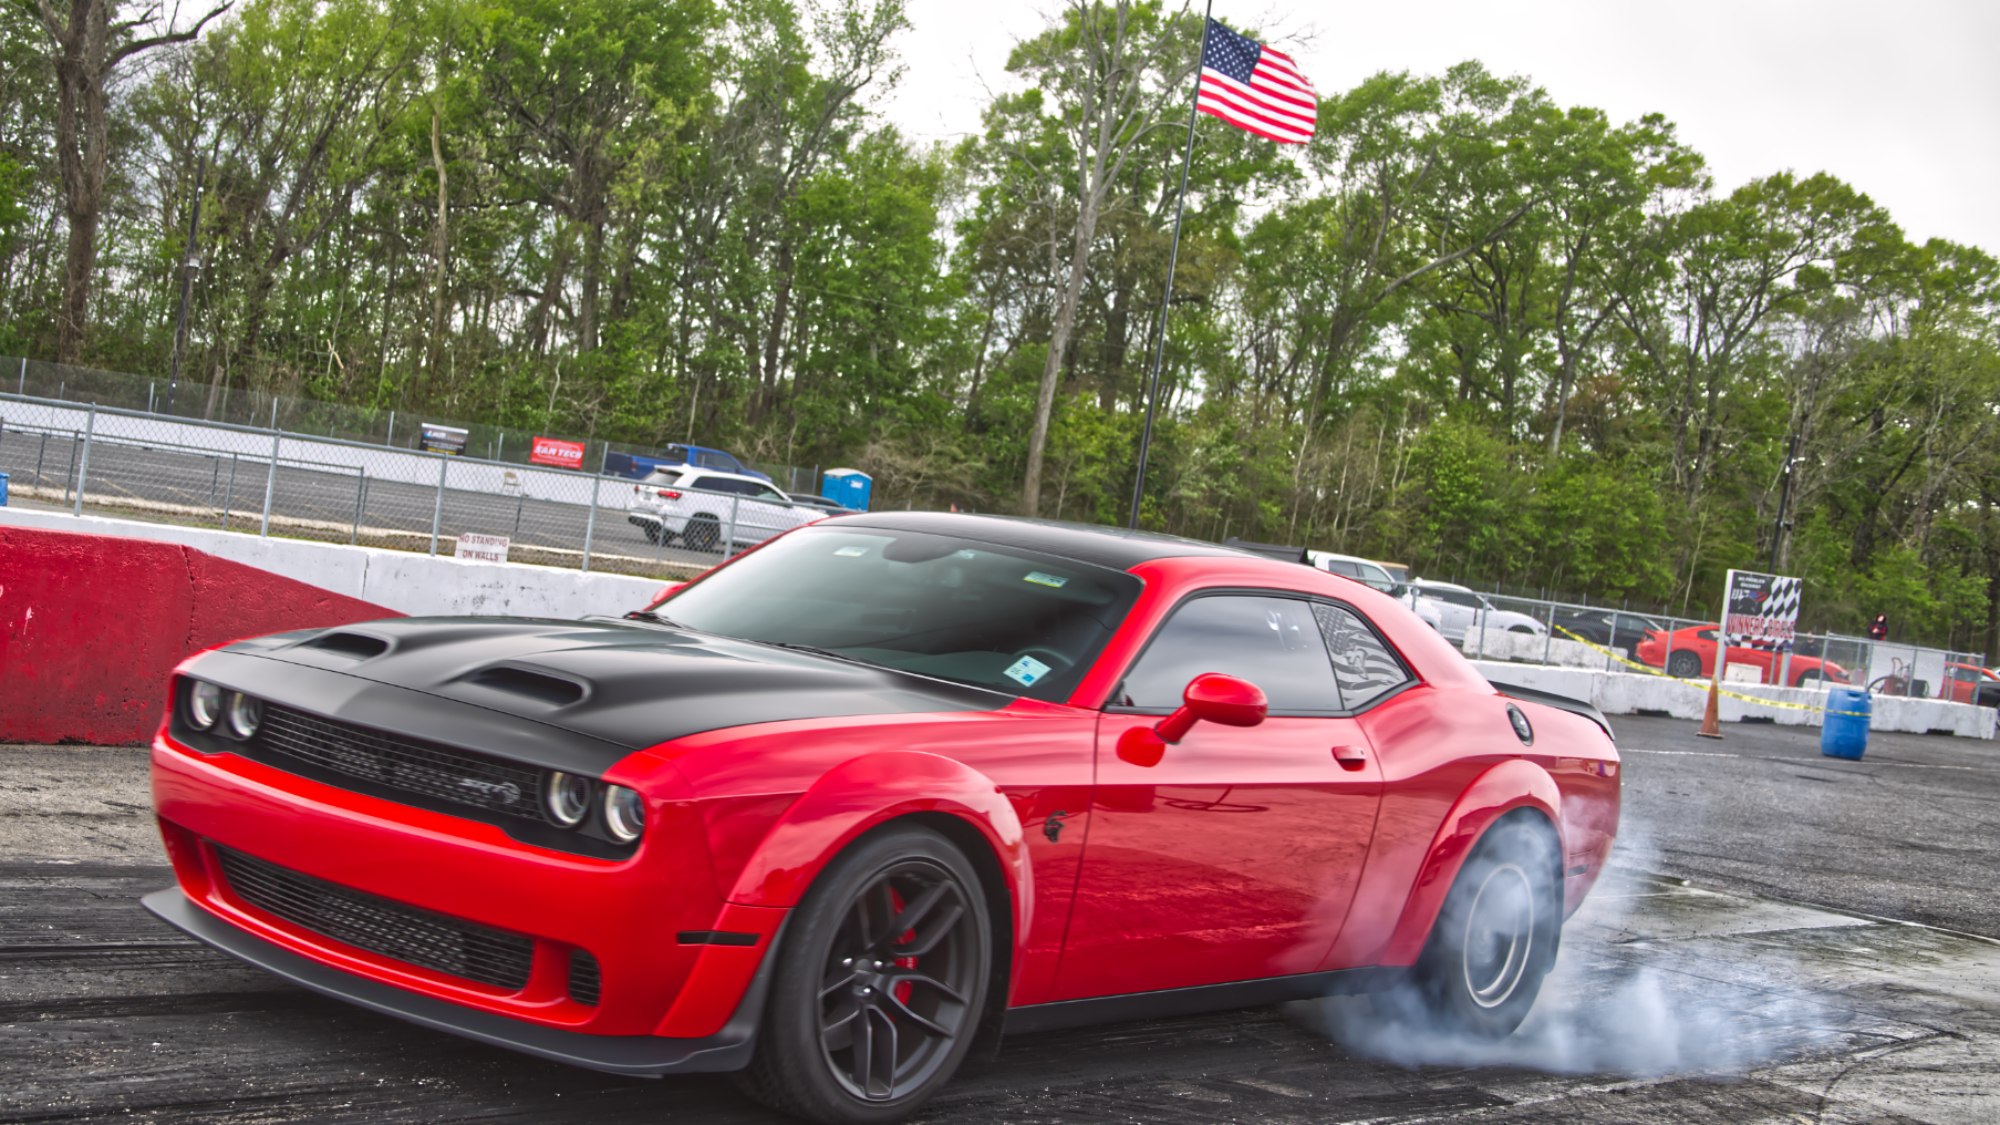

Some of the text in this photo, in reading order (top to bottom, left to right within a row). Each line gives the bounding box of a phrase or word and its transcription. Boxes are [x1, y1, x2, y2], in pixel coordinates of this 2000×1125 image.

[558, 448, 583, 459] TECH
[459, 534, 508, 548] NO STANDING
[462, 550, 499, 562] ON WALLS
[1767, 618, 1796, 640] CIRCLE
